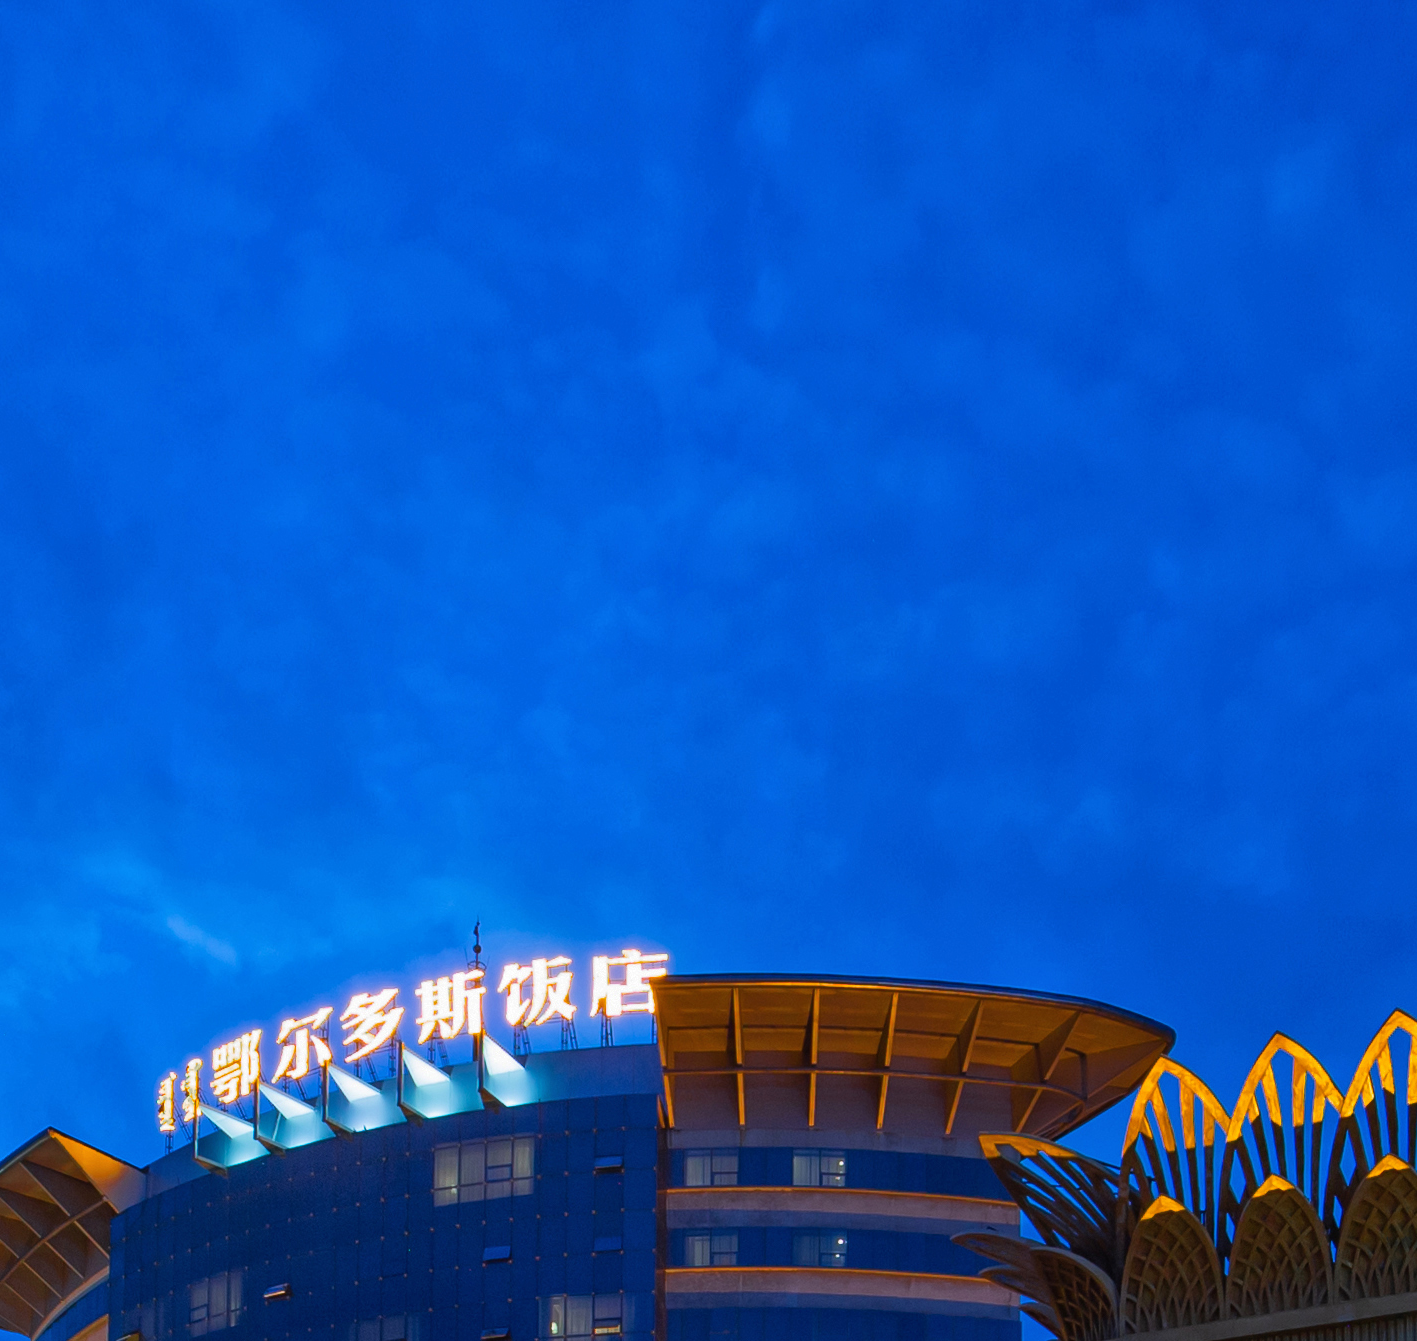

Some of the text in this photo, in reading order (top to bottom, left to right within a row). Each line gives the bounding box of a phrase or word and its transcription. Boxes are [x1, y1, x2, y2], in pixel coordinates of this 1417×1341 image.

[210, 949, 669, 1104] 鄂尔多斯饭店
